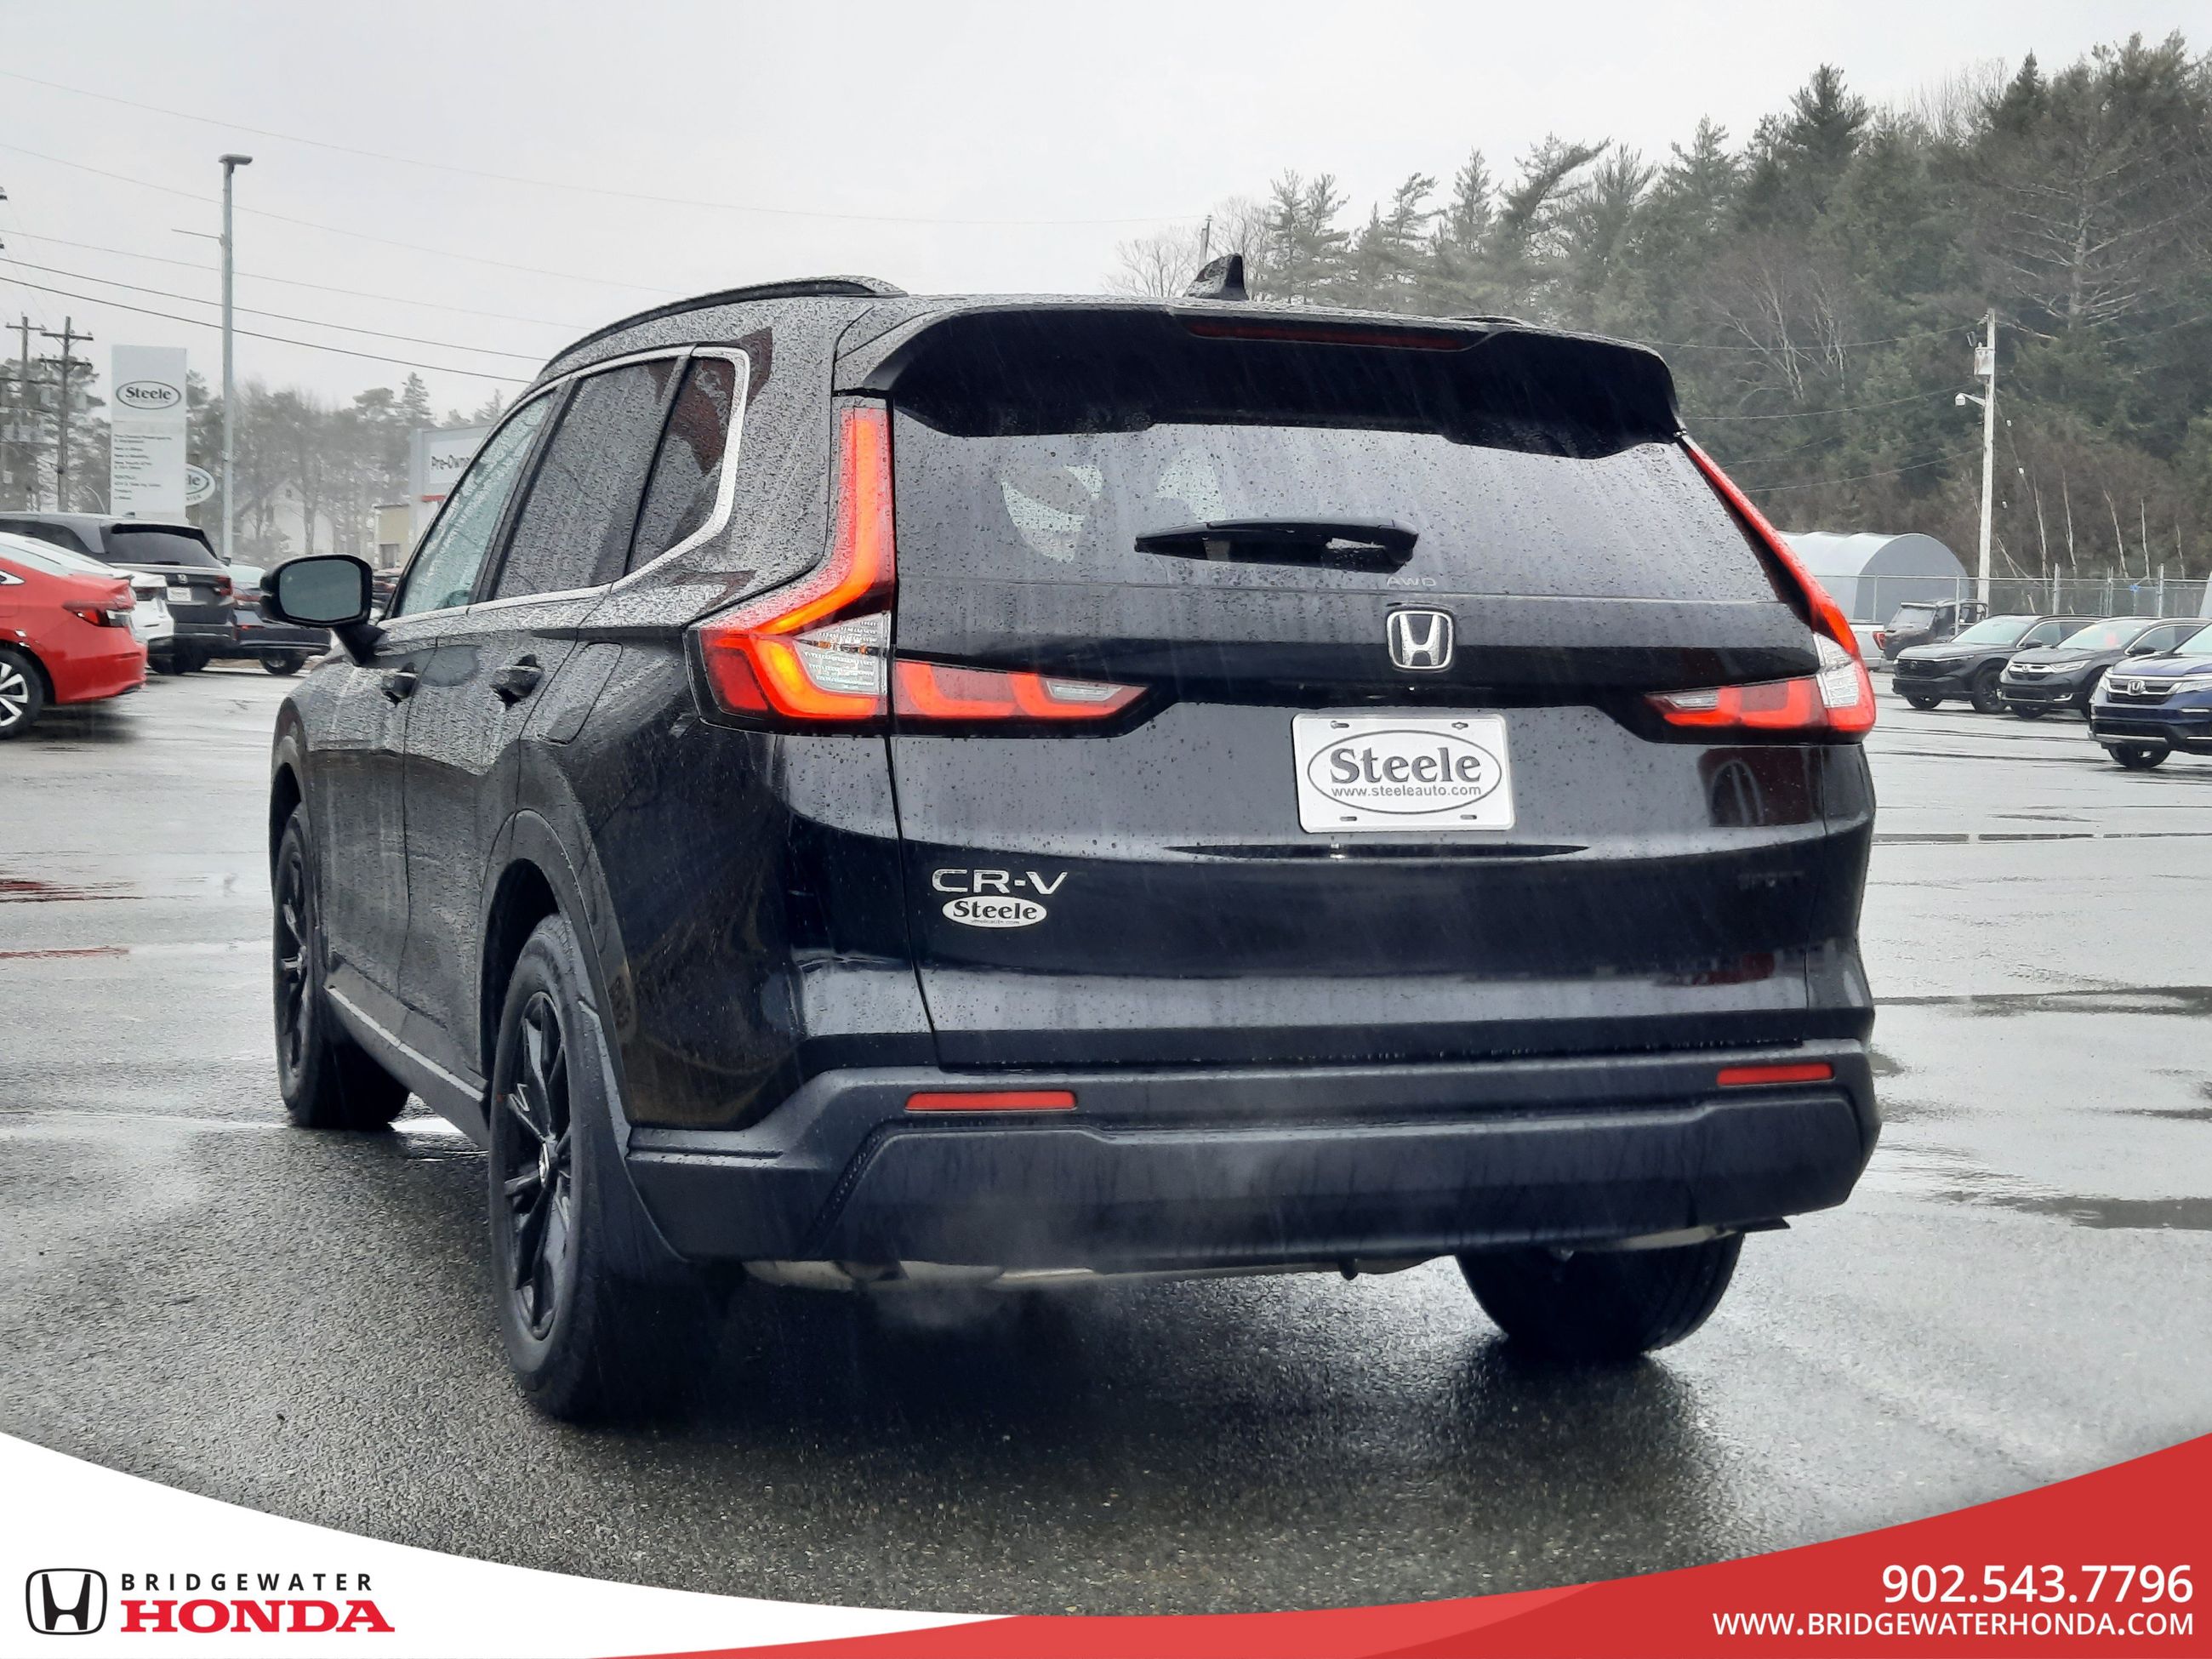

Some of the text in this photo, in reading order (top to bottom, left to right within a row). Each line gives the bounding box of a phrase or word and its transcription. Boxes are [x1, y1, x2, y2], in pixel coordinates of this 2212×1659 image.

[125, 387, 172, 400] Steele
[1387, 578, 1436, 587] AWD
[1329, 746, 1482, 784] Steele
[1331, 784, 1482, 797] www.steeleauto.com
[932, 869, 1069, 895] CR-V
[953, 900, 1038, 920] Steele
